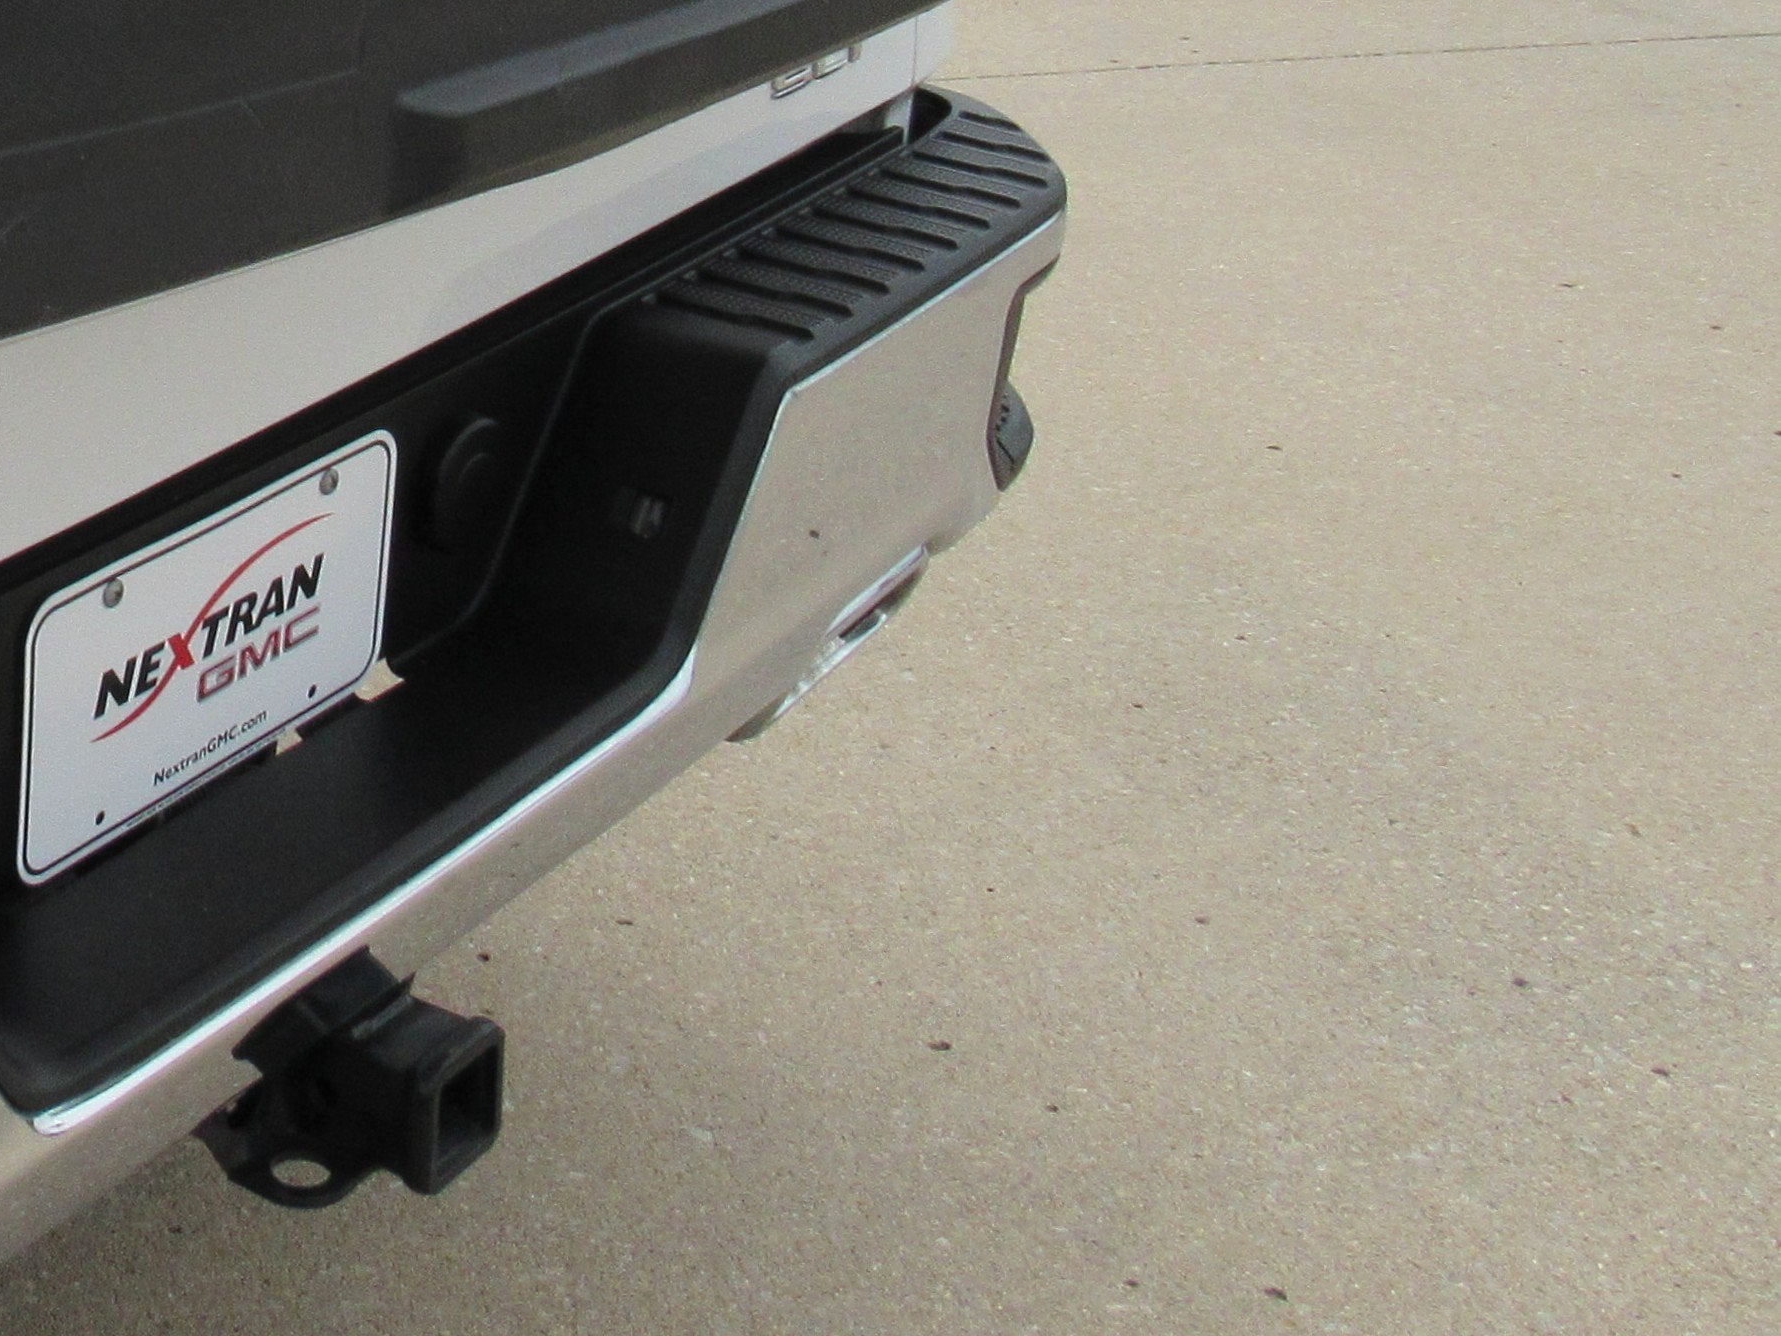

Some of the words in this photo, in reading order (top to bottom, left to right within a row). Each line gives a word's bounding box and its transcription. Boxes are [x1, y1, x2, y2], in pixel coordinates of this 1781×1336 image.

[93, 553, 324, 719] NEXTRAN
[196, 606, 320, 703] GMC
[152, 710, 268, 786] NextranGMC.com
